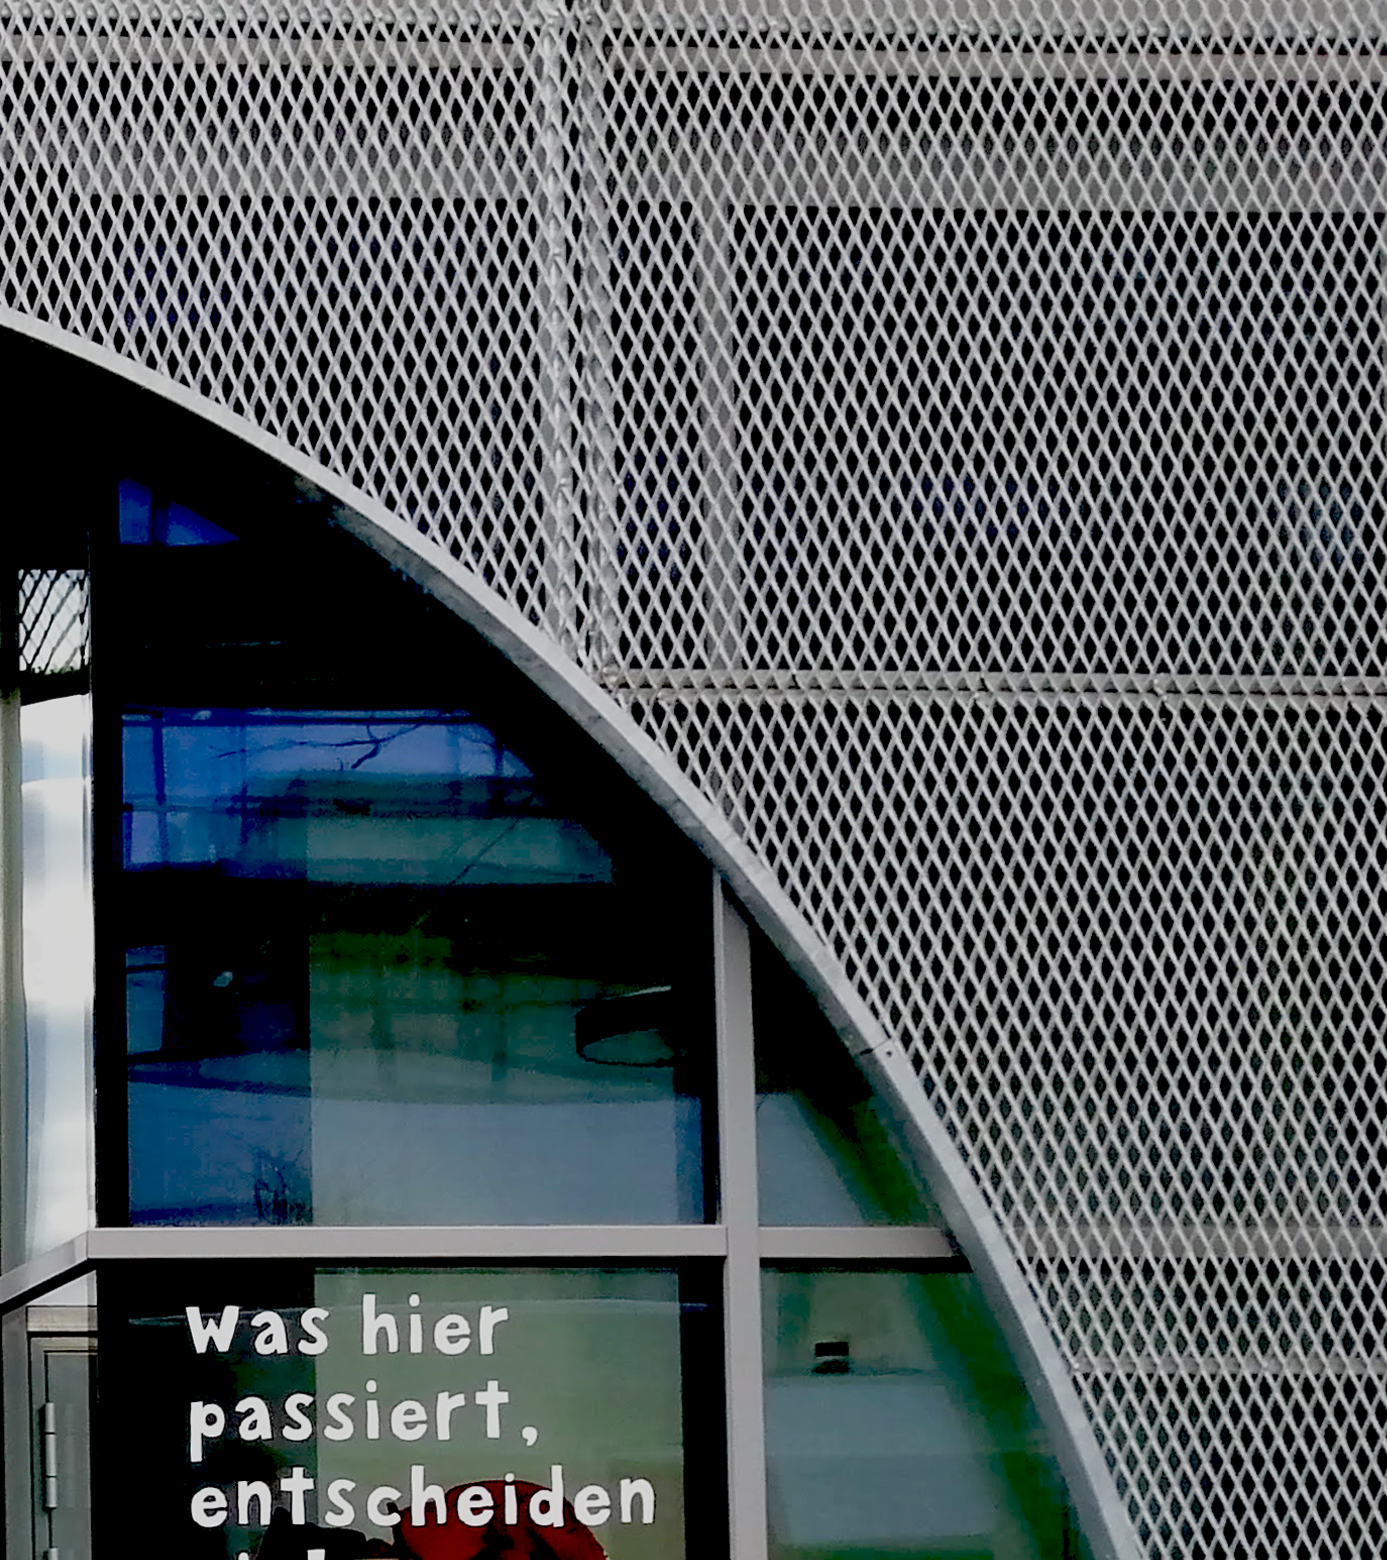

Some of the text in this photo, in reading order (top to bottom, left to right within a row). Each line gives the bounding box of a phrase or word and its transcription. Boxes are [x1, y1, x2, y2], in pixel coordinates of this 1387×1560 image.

[362, 1293, 510, 1356] hier
[188, 1380, 540, 1463] passiert,
[190, 1464, 656, 1528] entscheiden
